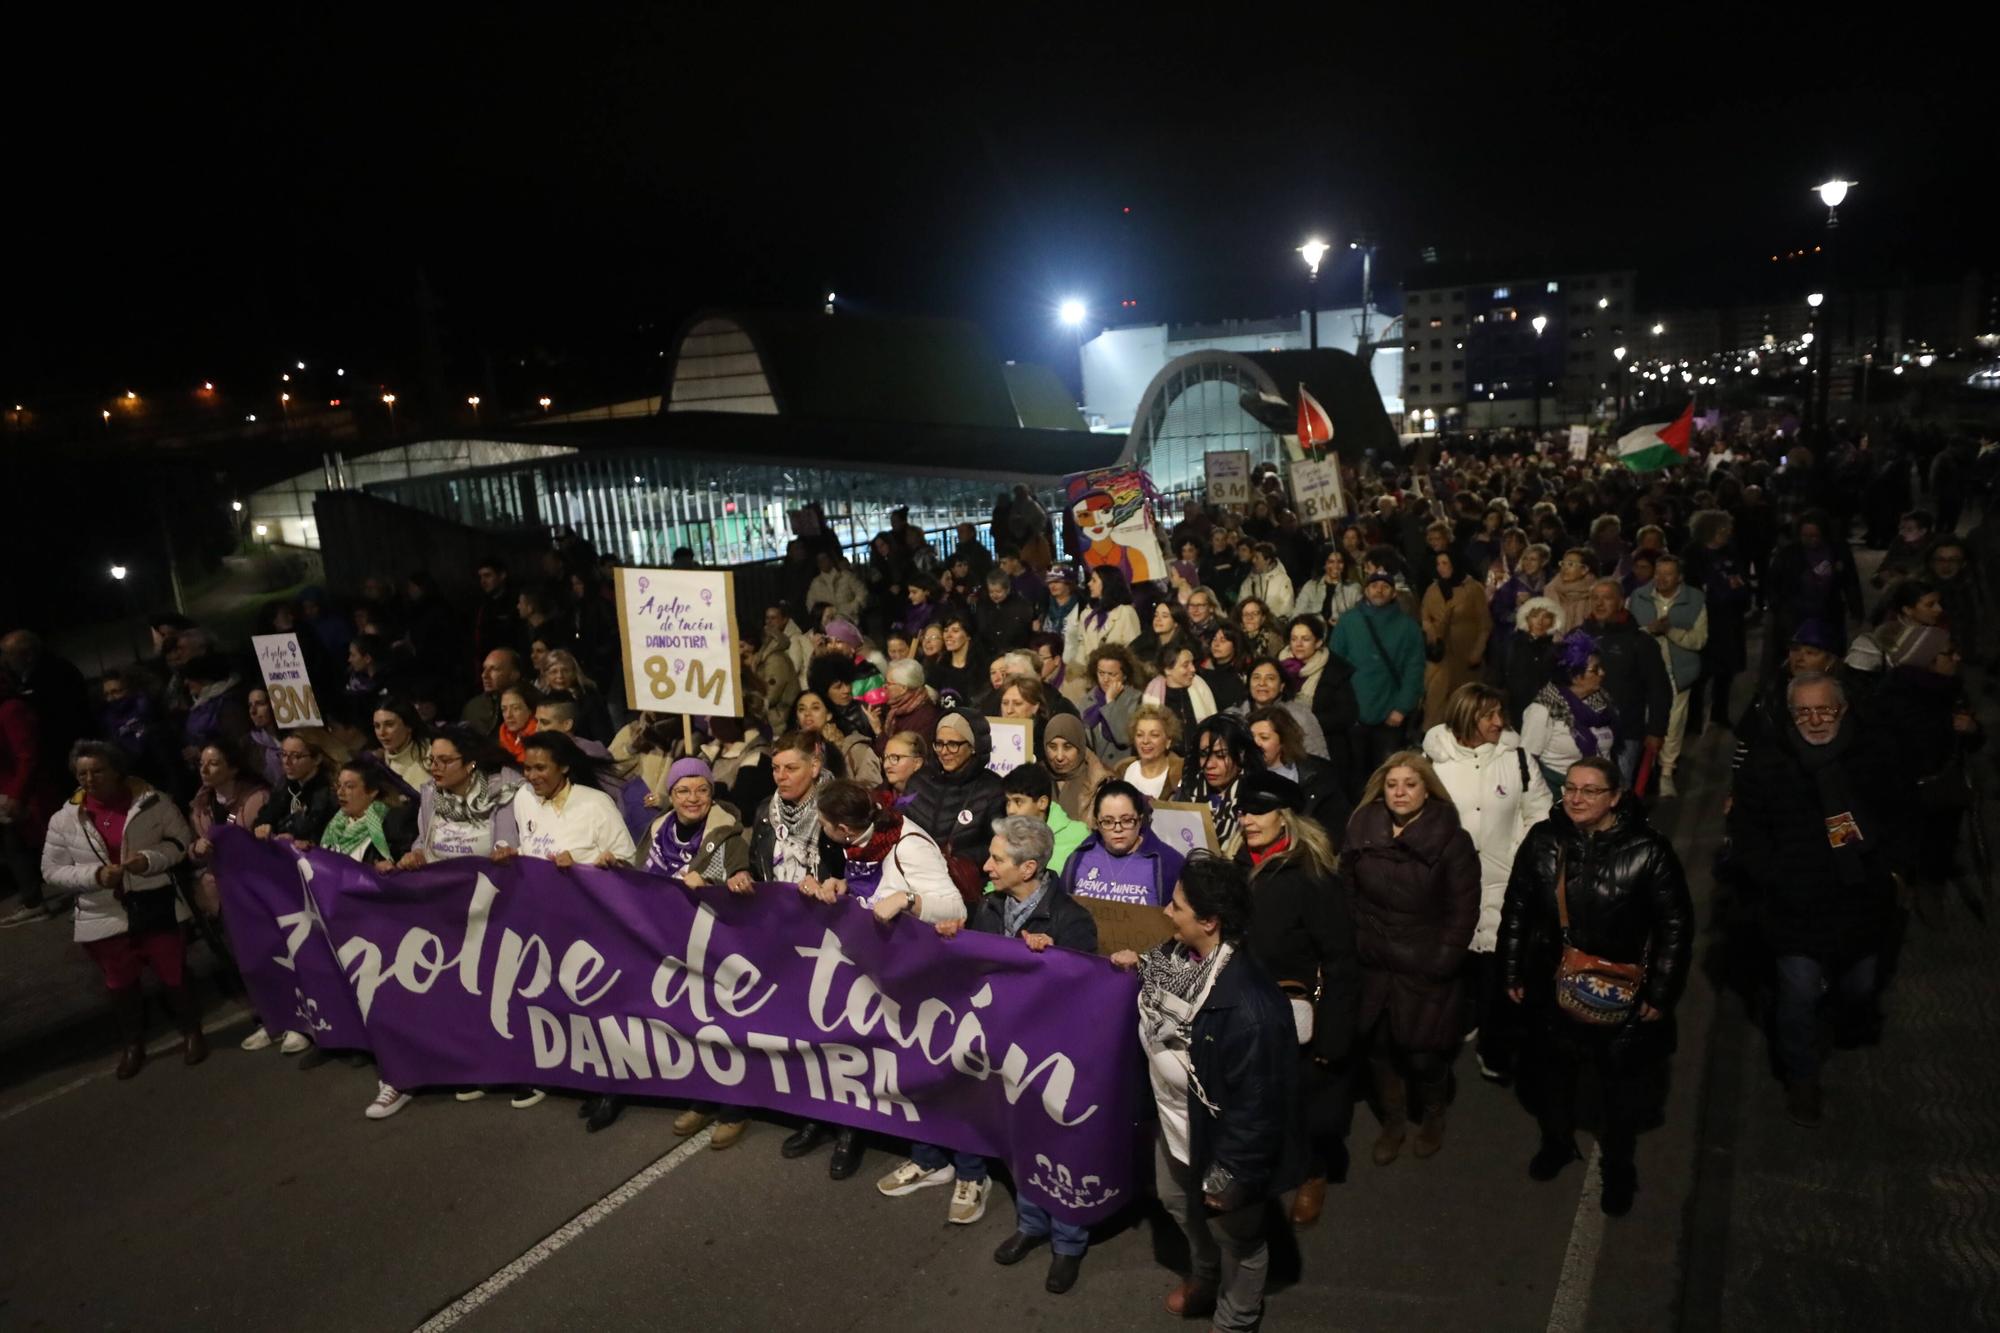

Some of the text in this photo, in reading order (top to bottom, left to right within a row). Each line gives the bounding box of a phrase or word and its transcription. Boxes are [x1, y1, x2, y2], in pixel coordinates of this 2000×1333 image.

[638, 596, 691, 620] A golpe
[660, 616, 714, 632] de tacón
[646, 635, 708, 649] DANDO TIRA
[337, 871, 621, 1040] golpe
[651, 901, 778, 1023] de
[795, 928, 1098, 1126] tacón
[528, 1005, 920, 1122] DANDO TIRA
